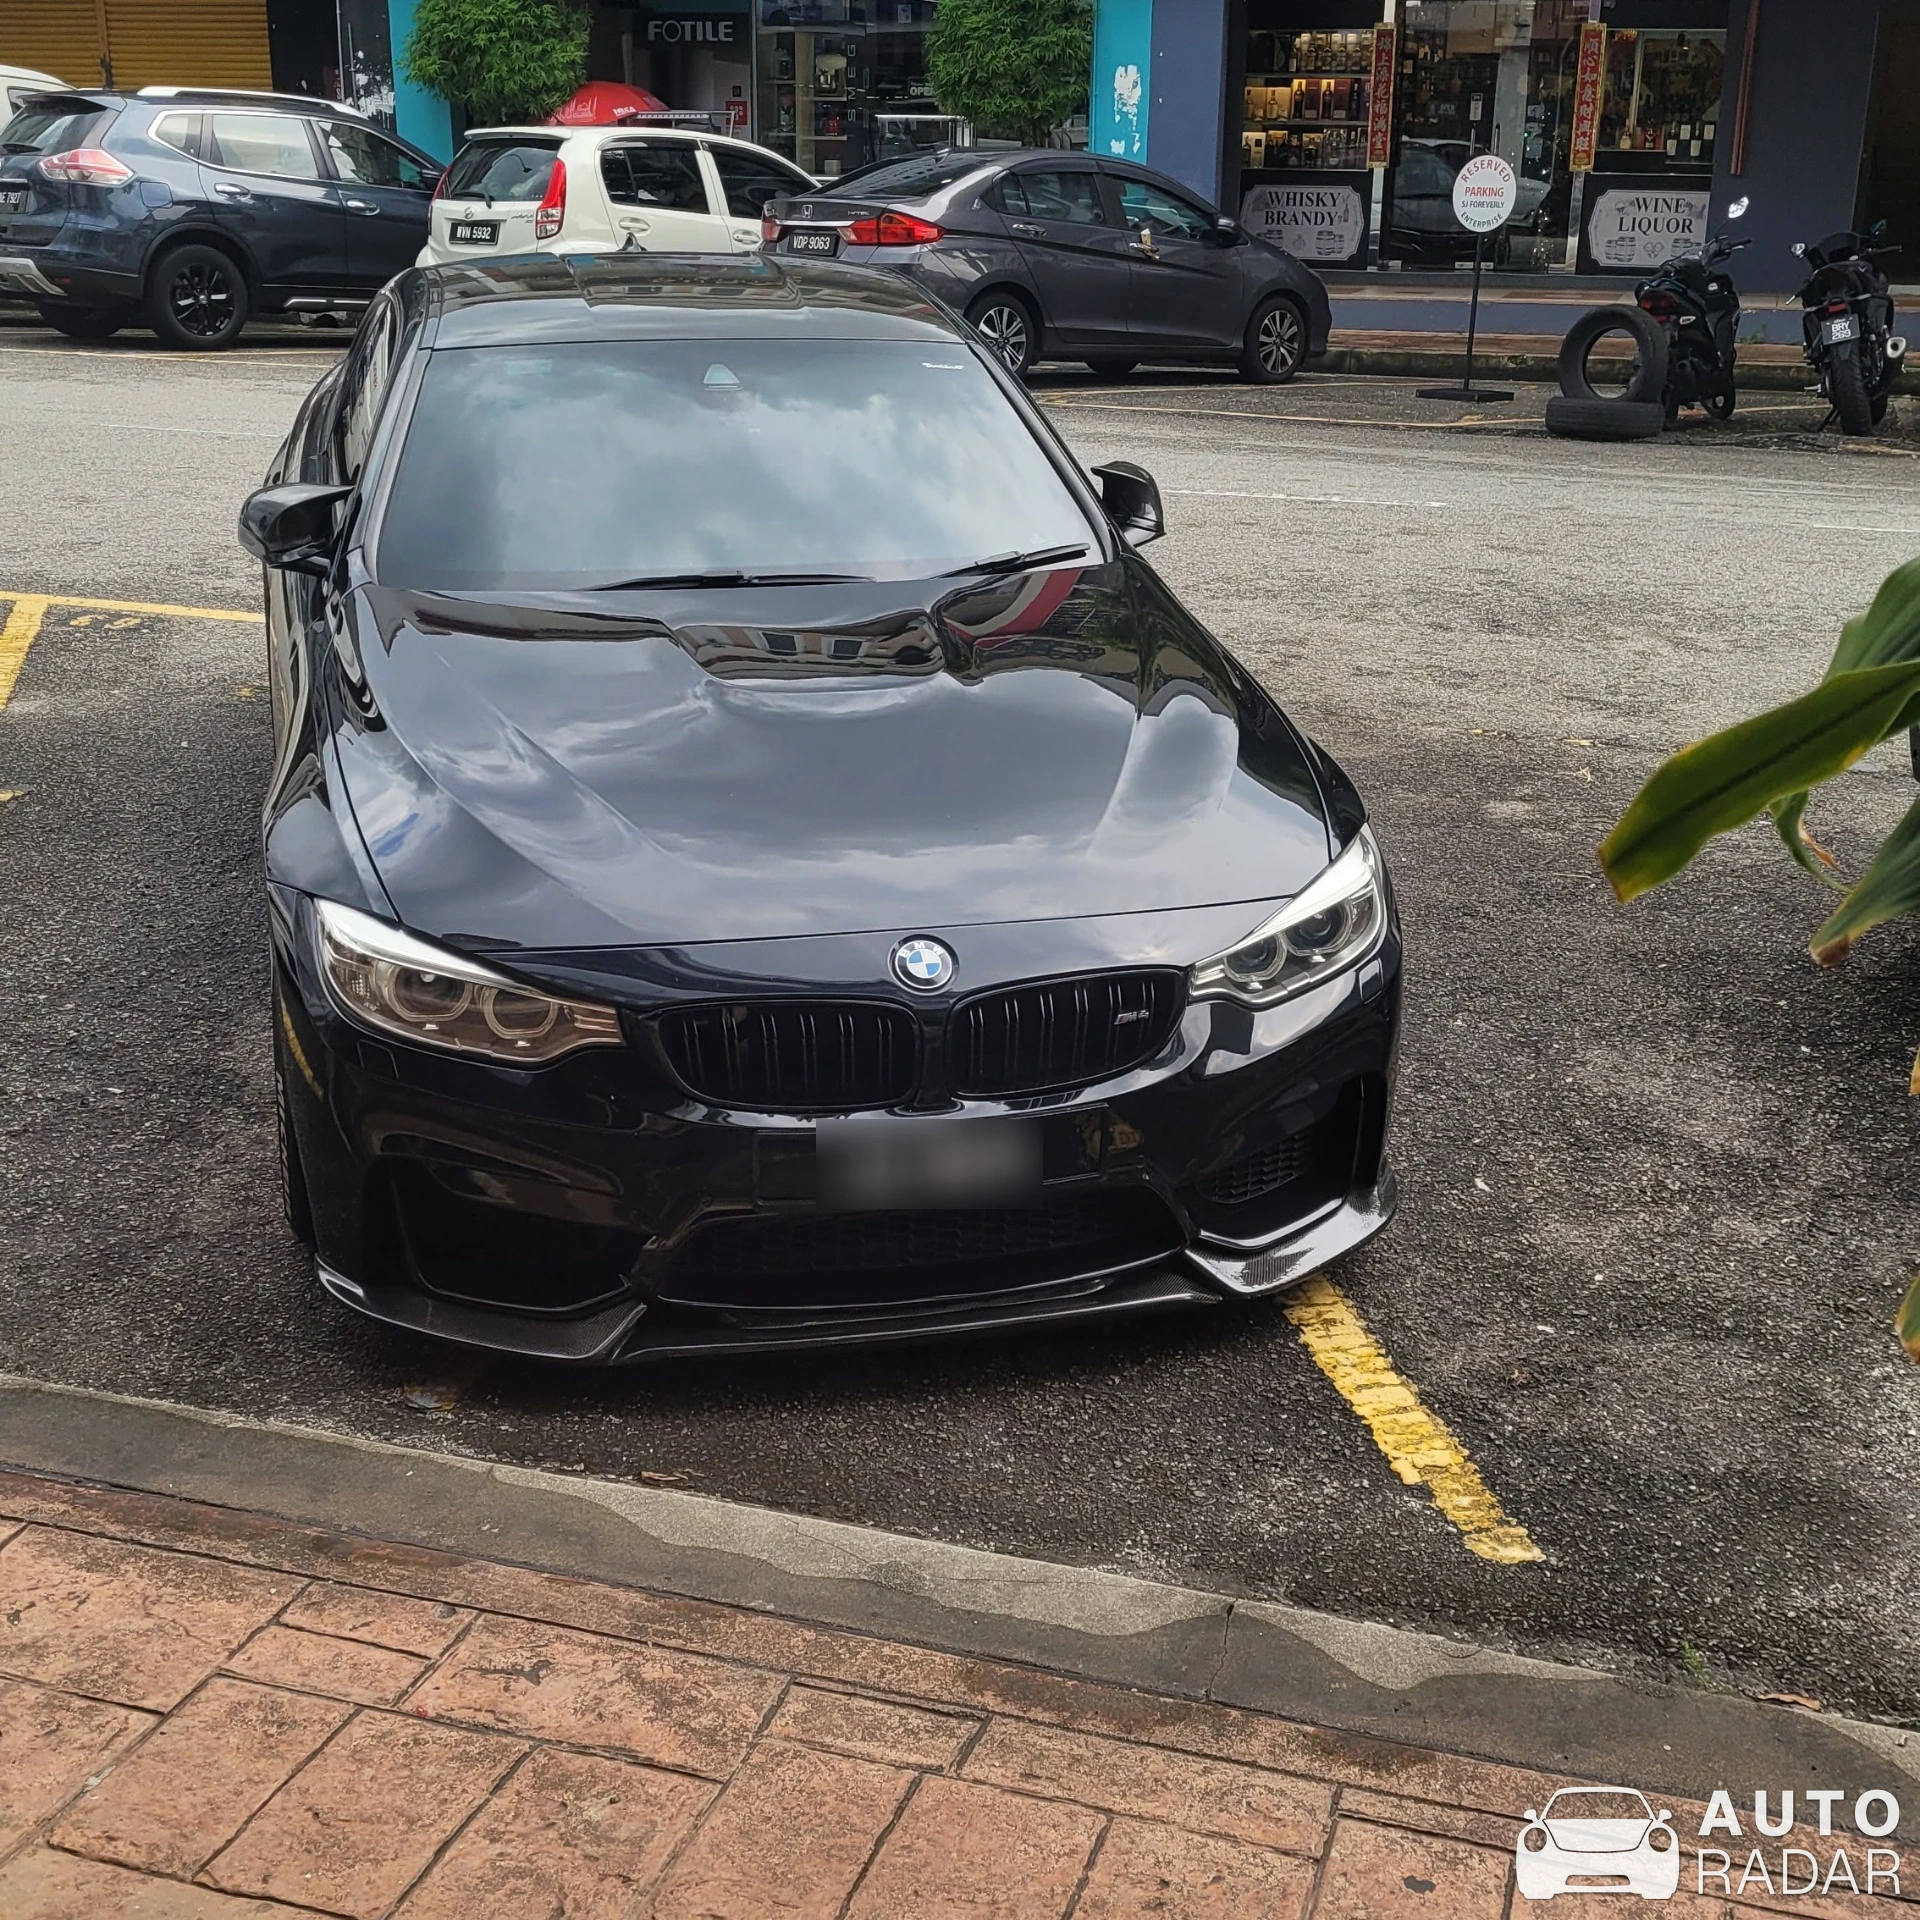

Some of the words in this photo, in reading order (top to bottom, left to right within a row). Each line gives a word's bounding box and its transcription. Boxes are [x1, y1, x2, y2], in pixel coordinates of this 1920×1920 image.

[647, 20, 734, 42] FOTILE
[847, 44, 856, 122] SMEG
[909, 86, 935, 96] OPE
[1461, 159, 1511, 183] RESERVED
[1267, 191, 1341, 208] WHISKY
[1464, 186, 1504, 198] PARKING
[1469, 200, 1505, 209] FOREVERLY
[1635, 197, 1686, 214] WINE
[1264, 210, 1338, 226] BRANDY
[1461, 211, 1503, 229] ENTERPRISE
[1618, 216, 1694, 236] LIQUOR
[472, 225, 492, 240] 5932
[793, 235, 808, 249] VDP
[808, 235, 831, 250] 9063
[1831, 320, 1850, 333] BRY
[1831, 328, 1852, 341] 269
[899, 942, 945, 958] BMW
